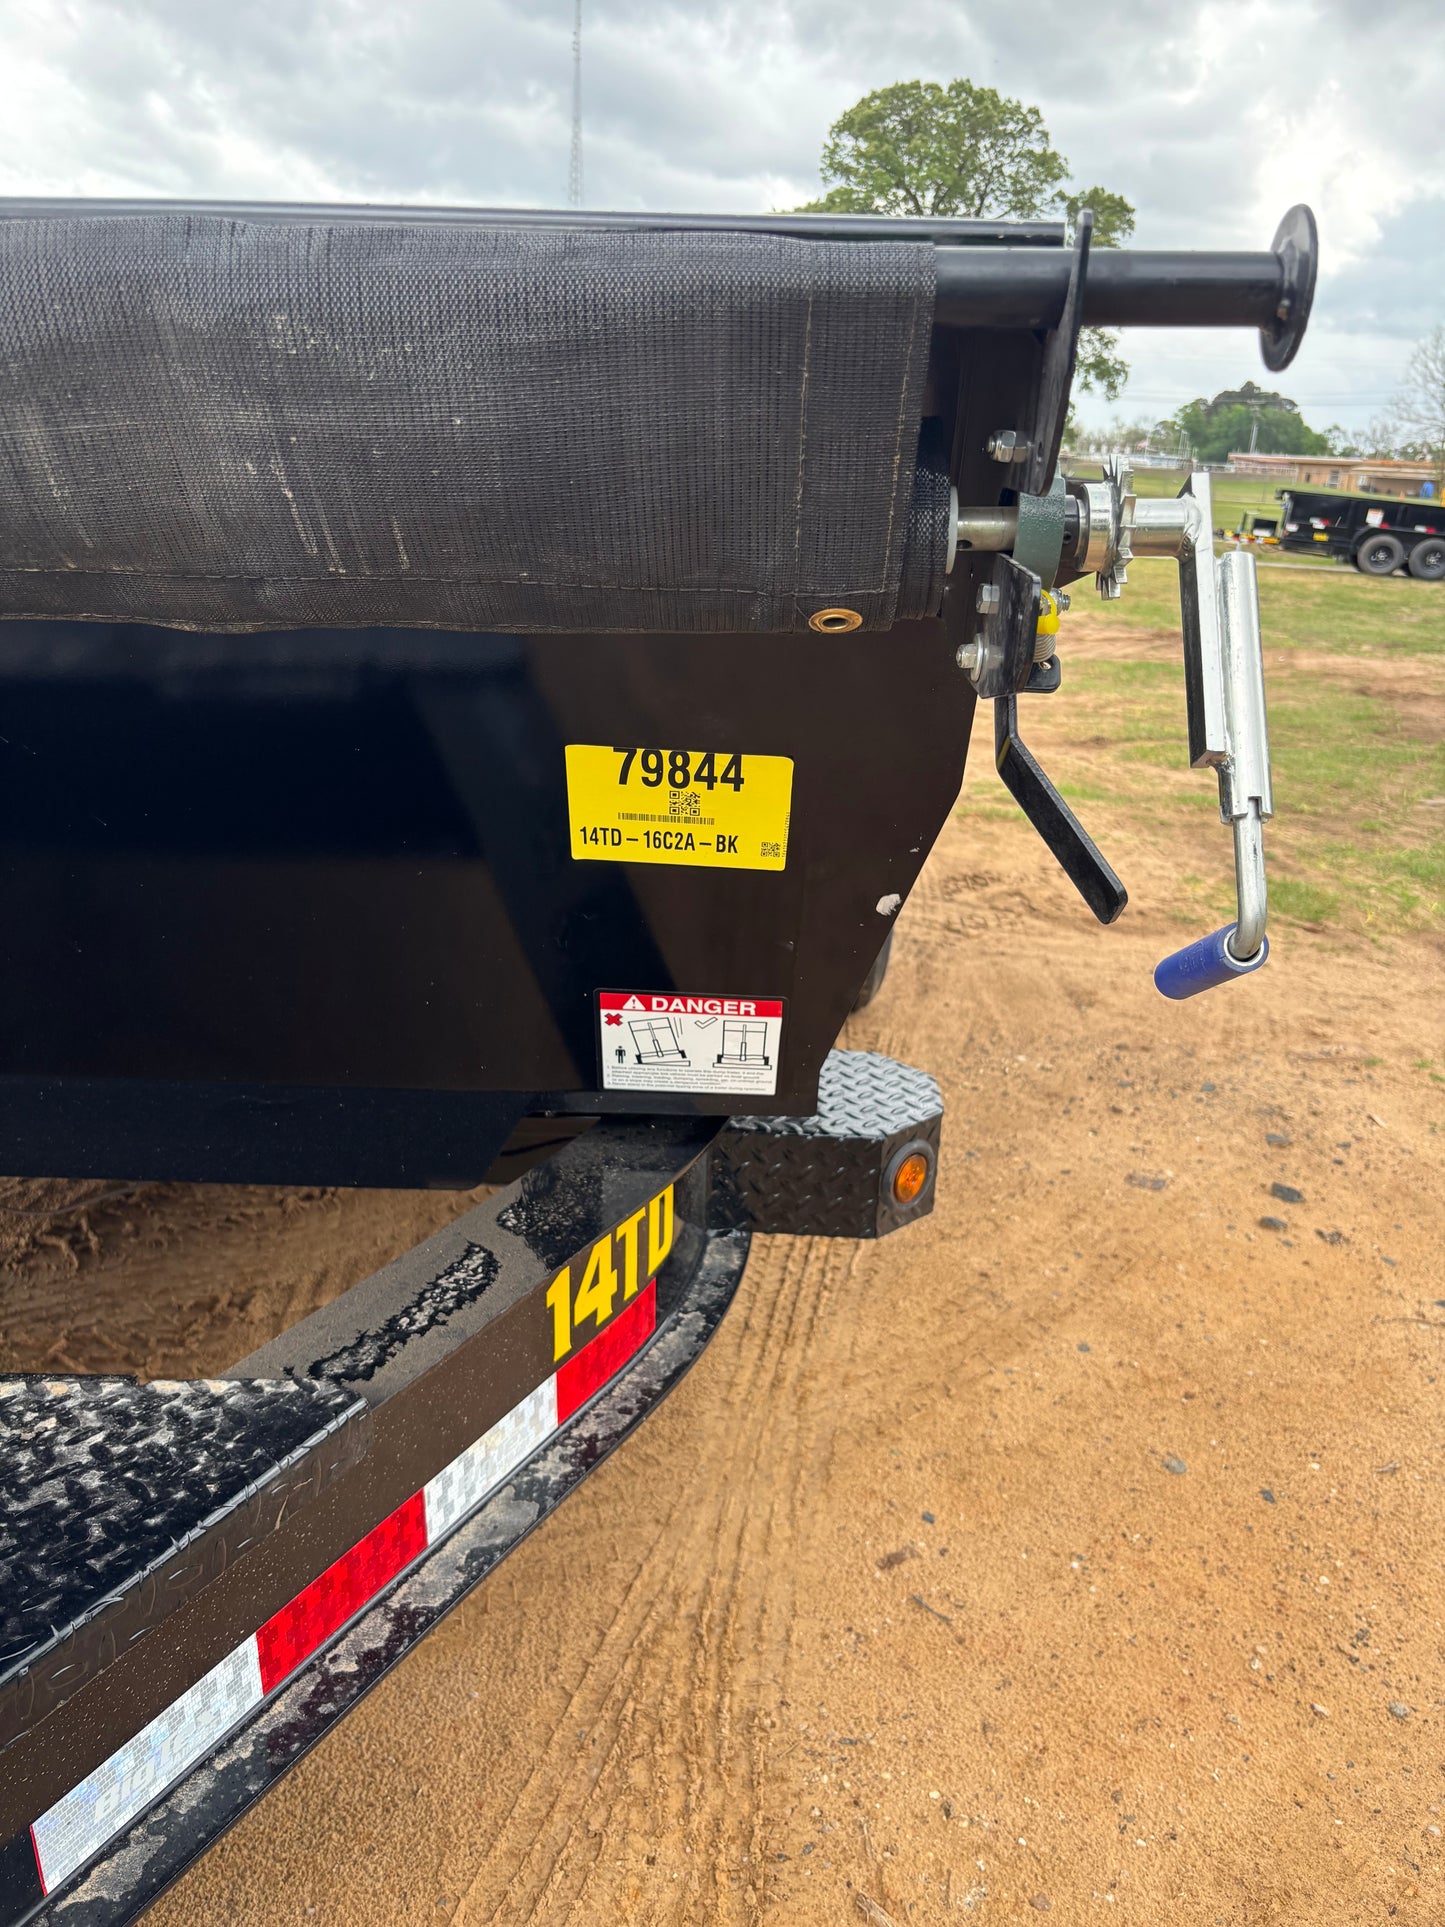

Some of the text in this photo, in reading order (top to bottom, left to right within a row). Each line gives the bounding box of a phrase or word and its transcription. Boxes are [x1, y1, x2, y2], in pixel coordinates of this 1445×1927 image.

[613, 747, 745, 792] 79844
[651, 997, 756, 1016] DANGER
[545, 1183, 674, 1363] 14TD
